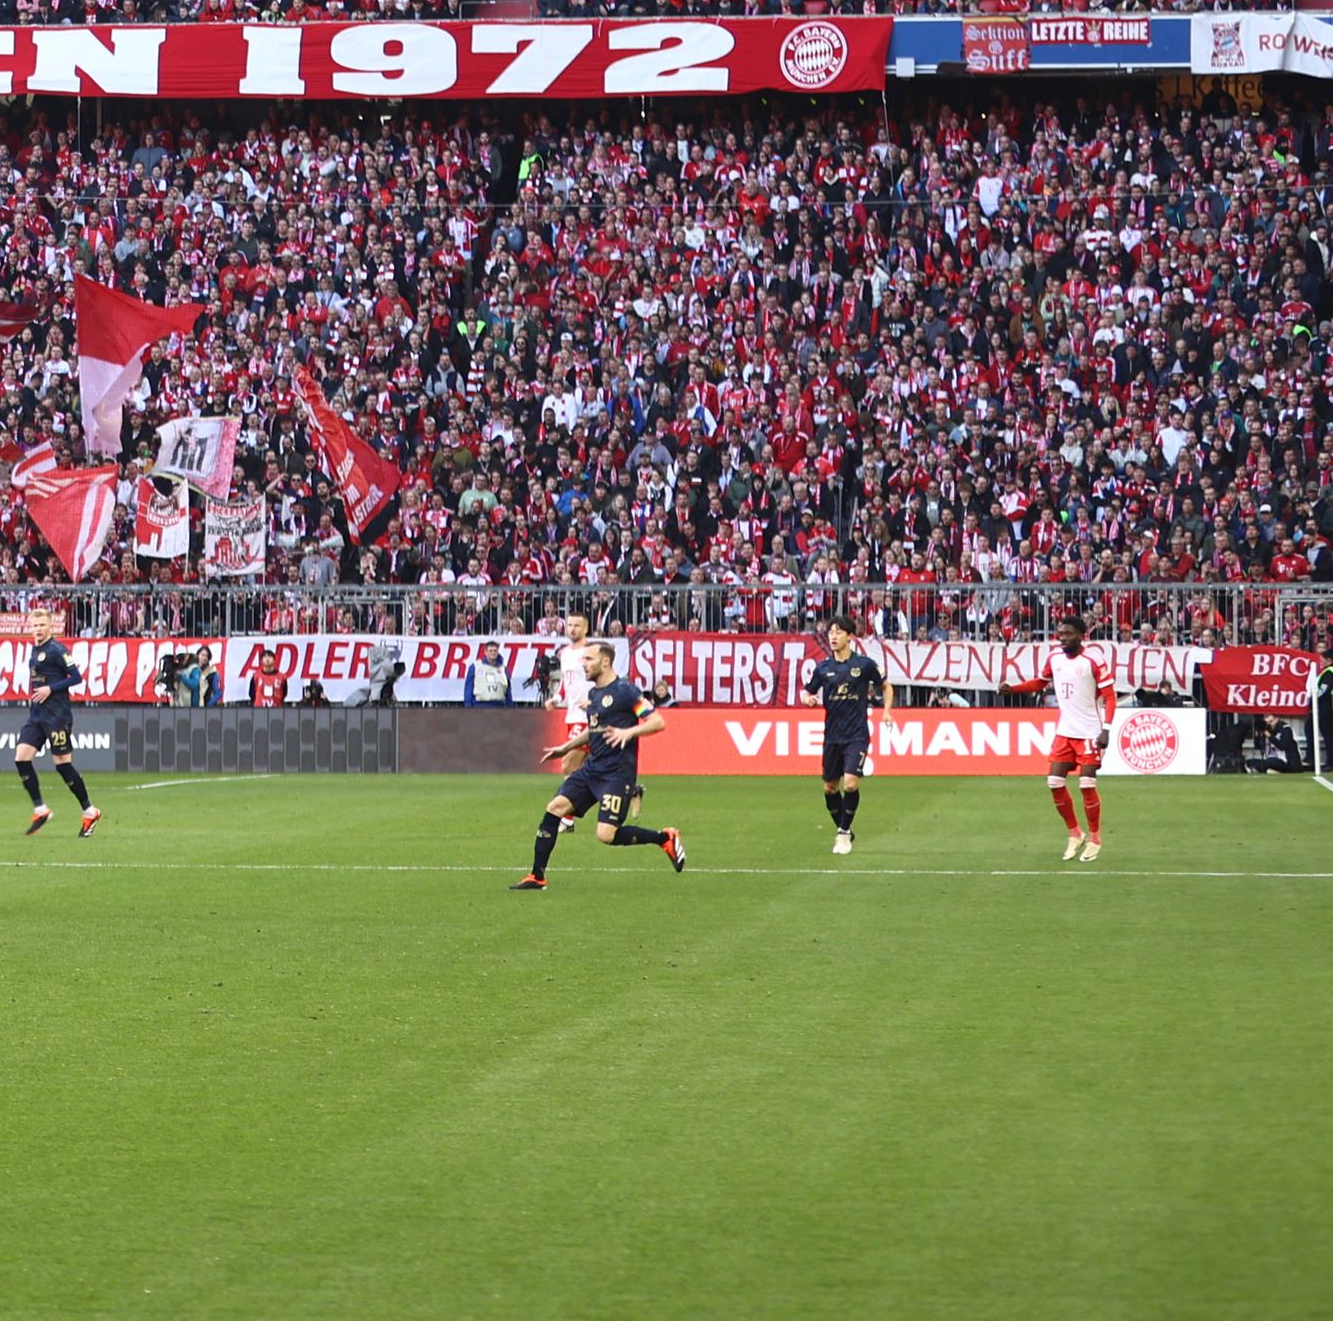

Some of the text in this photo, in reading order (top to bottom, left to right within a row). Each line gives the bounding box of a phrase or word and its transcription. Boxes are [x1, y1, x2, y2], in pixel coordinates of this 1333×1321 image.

[803, 25, 841, 49] BAYERN
[966, 24, 1026, 41] Sektion
[1031, 22, 1149, 42] LETZTE REIHE
[241, 22, 734, 97] 1972
[635, 641, 774, 705] SELTERS
[1251, 654, 1309, 677] BFC
[1122, 714, 1173, 737] FC BAYERN
[51, 731, 67, 747] 29
[724, 709, 1056, 776] VIEMANN
[858, 753, 867, 771] 7
[1123, 748, 1173, 772] MÜNCHEN
